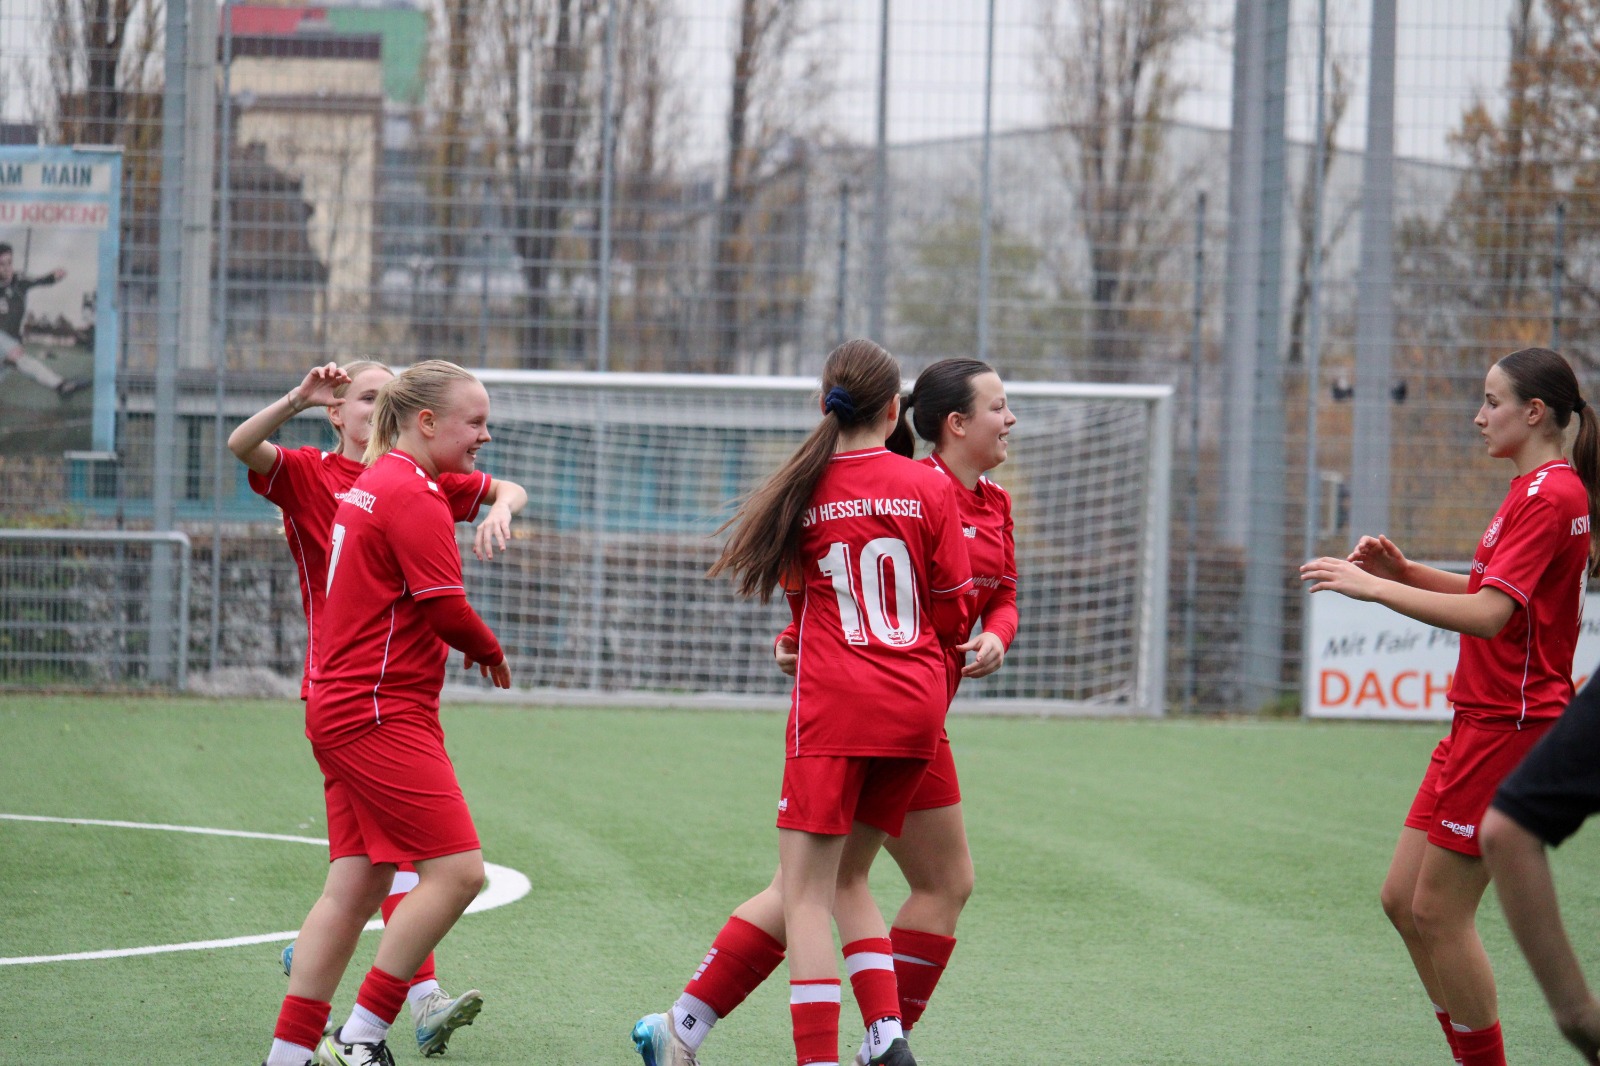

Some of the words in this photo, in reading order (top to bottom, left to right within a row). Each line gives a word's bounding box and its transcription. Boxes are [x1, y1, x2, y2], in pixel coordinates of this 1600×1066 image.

[41, 163, 92, 187] MAIN
[803, 507, 817, 527] SV
[819, 499, 873, 522] HESSEN
[874, 498, 923, 519] KASSEL
[817, 537, 920, 647] 10
[1322, 632, 1366, 658] Mit
[1374, 628, 1422, 654] Fair
[1441, 820, 1475, 835] capelli
